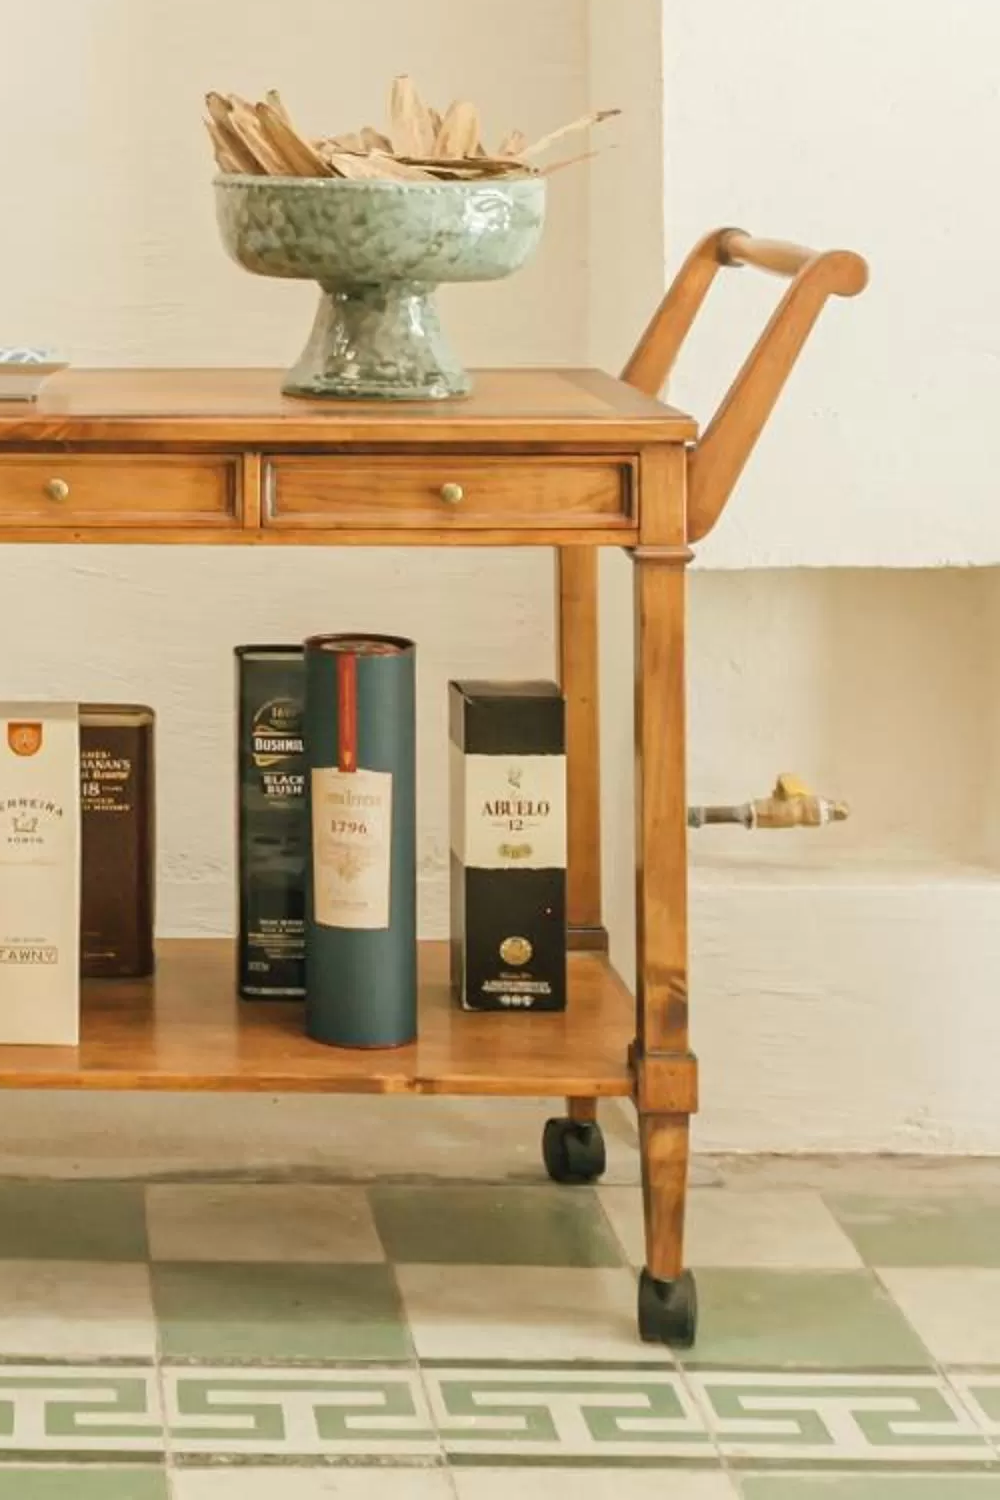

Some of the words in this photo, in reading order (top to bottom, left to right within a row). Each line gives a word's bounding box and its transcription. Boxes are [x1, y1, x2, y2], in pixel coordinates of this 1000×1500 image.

[255, 738, 305, 752] BUSHMIL
[83, 781, 100, 797] 18
[482, 800, 550, 816] ABUELO
[509, 819, 523, 831] 12
